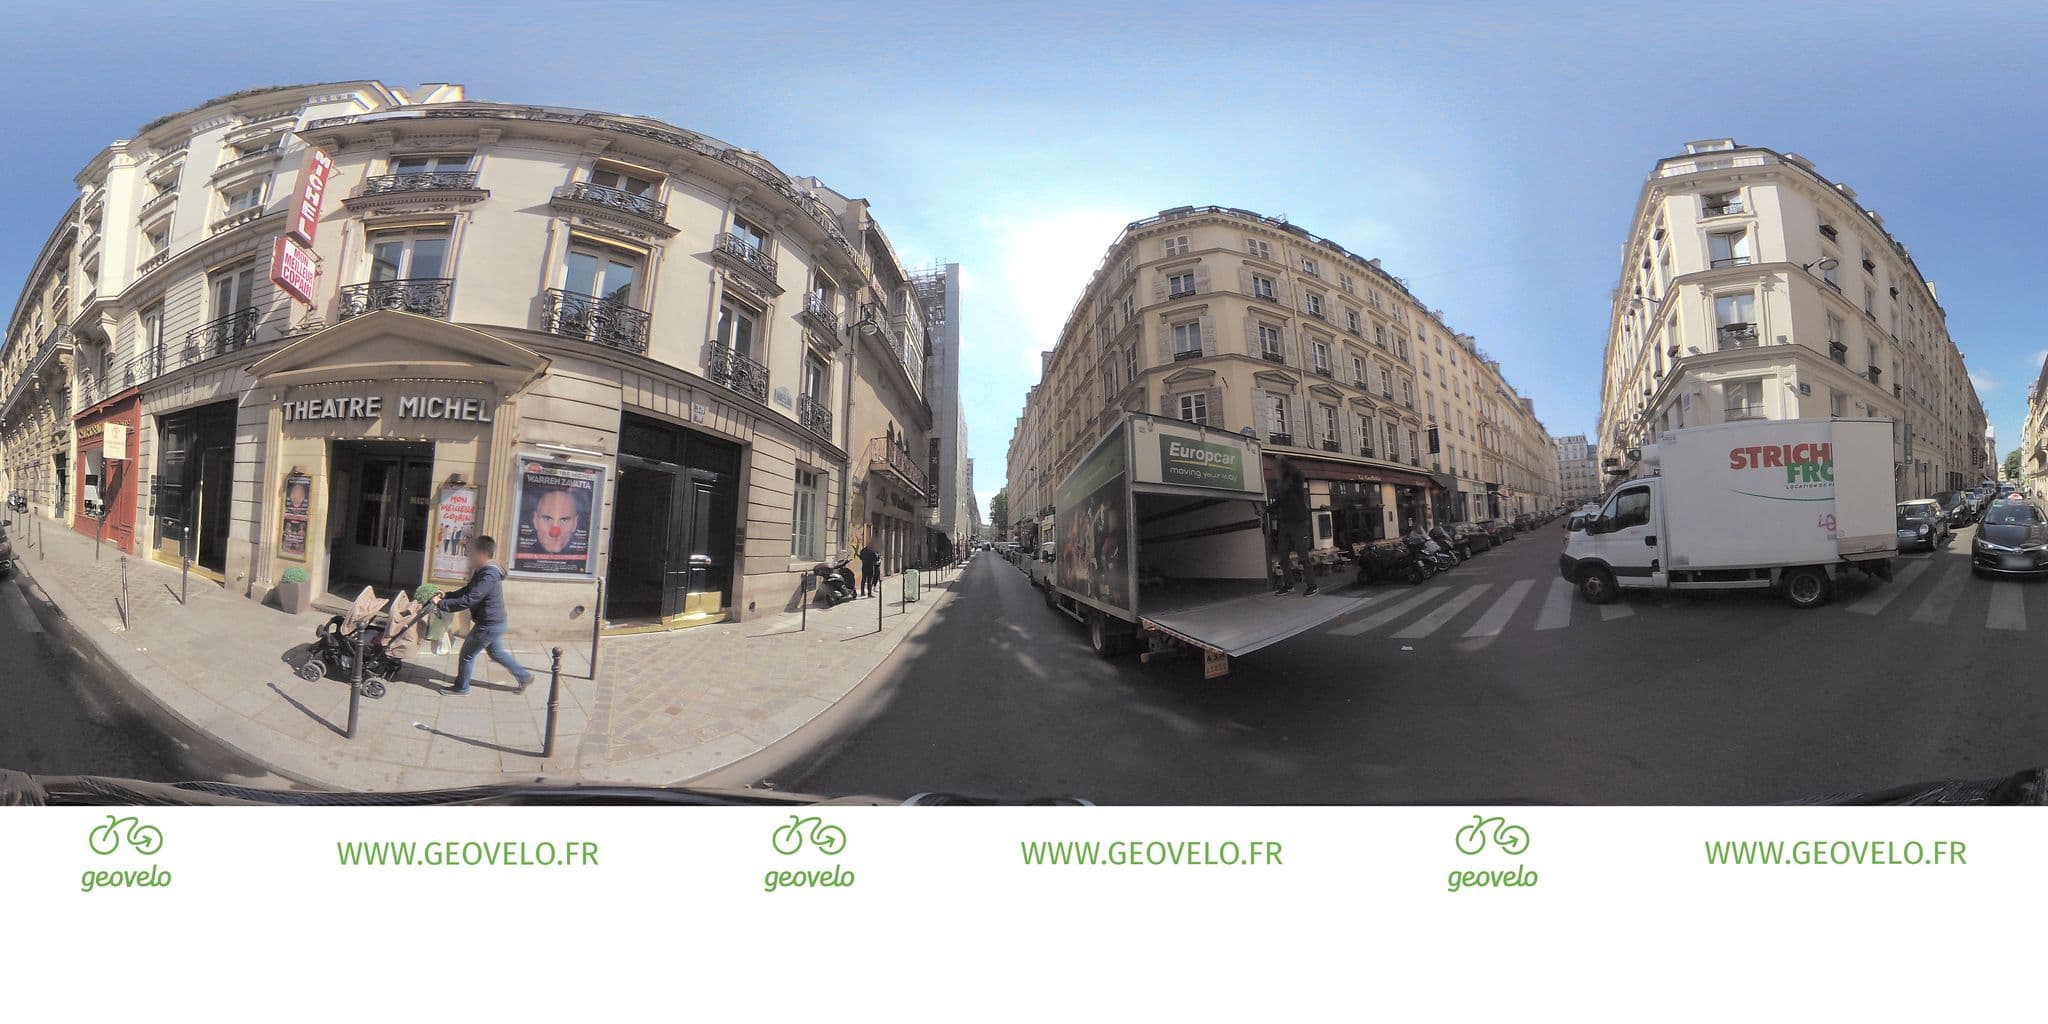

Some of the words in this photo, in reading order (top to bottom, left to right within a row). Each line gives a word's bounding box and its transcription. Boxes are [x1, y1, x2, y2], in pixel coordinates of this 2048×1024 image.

[298, 150, 331, 241] MICHEL
[284, 253, 314, 285] MEILLEUR
[294, 248, 310, 267] MON
[283, 266, 312, 298] COPAIN
[283, 396, 382, 421] THEATRE
[398, 396, 492, 422] MICHEL
[1169, 441, 1236, 466] Europcar
[1729, 442, 1834, 470] STRICH
[527, 474, 560, 486] WARREN
[561, 478, 591, 489] ZAVATTA
[1169, 466, 1202, 479] moving
[1203, 471, 1220, 479] your
